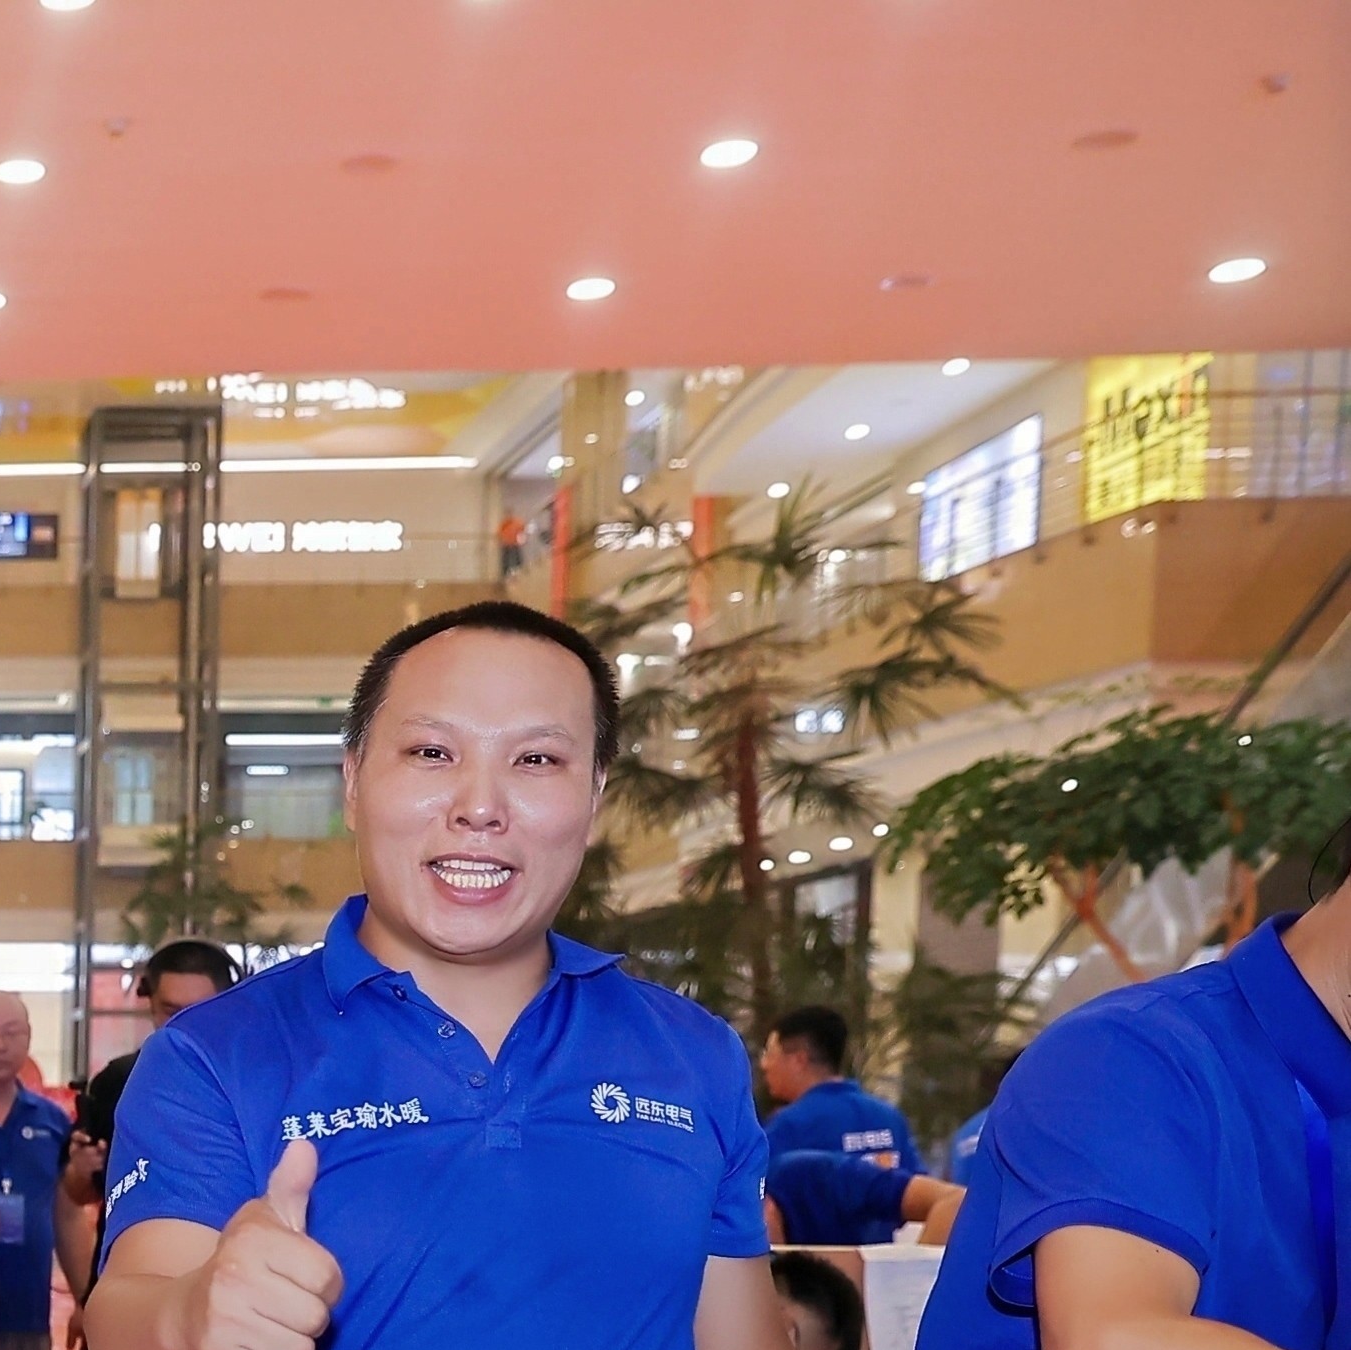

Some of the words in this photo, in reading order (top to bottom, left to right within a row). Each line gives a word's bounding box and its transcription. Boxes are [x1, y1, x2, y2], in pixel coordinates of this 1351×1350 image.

[280, 1096, 431, 1143] 蓬莱宝瑜水暖
[635, 1096, 694, 1126] 远东电气
